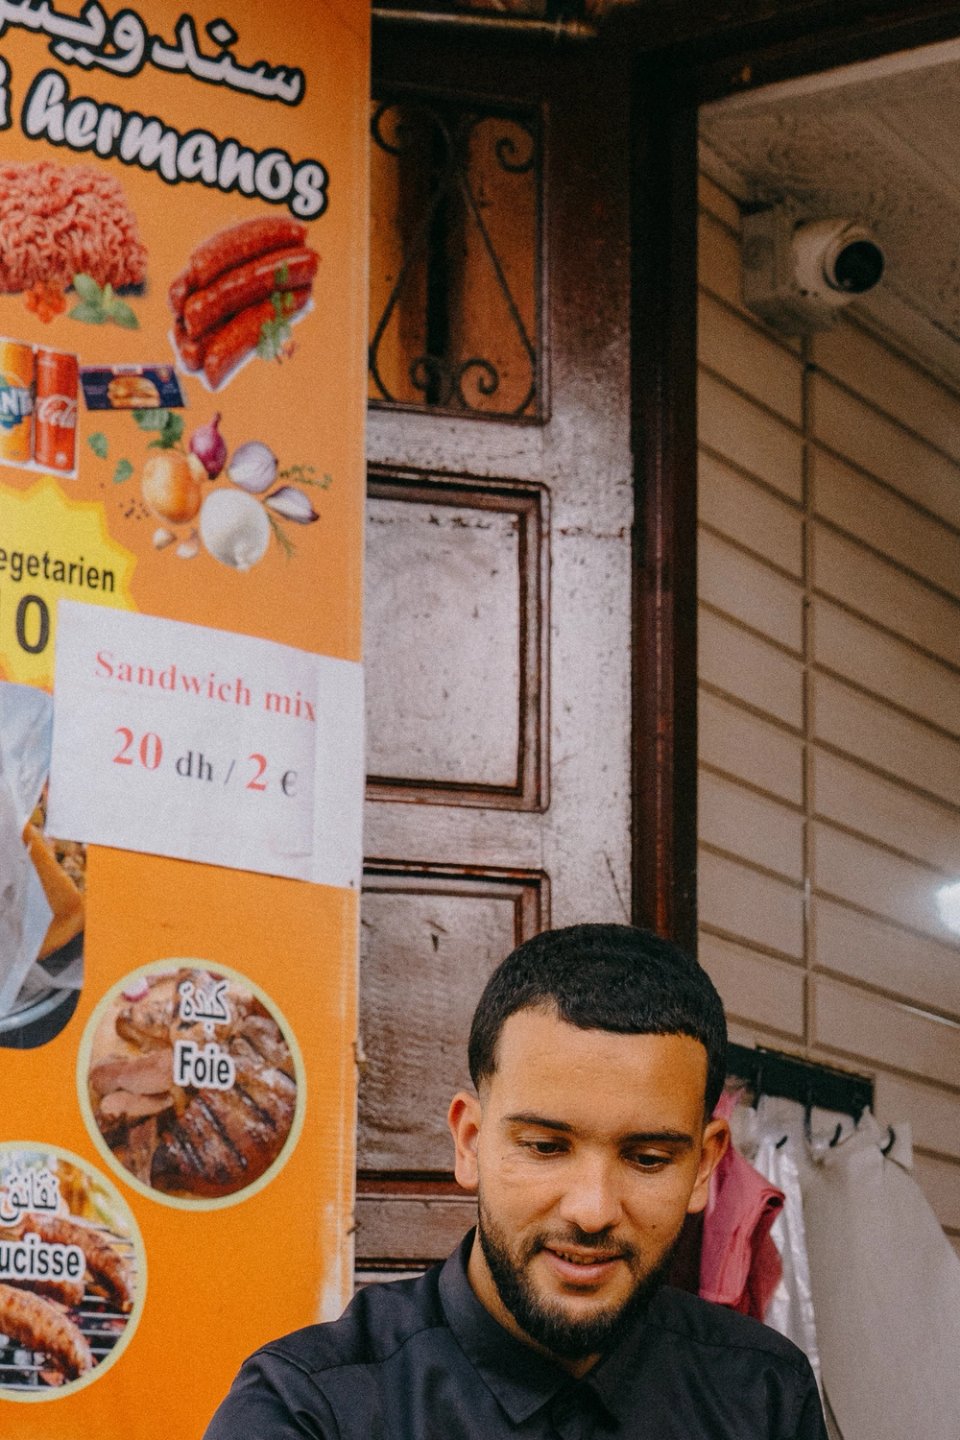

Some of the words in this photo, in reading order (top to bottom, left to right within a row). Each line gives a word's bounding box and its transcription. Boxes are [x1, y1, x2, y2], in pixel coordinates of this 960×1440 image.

[22, 68, 328, 220] hermanos
[95, 649, 251, 707] Sandwich
[264, 690, 317, 722] mix
[112, 726, 164, 771] 20
[175, 750, 214, 782] dh
[245, 752, 268, 791] 2
[280, 769, 299, 797] €
[182, 985, 228, 1031] كبدة
[179, 1045, 231, 1085] Foie
[0, 1238, 81, 1277] ucisse
